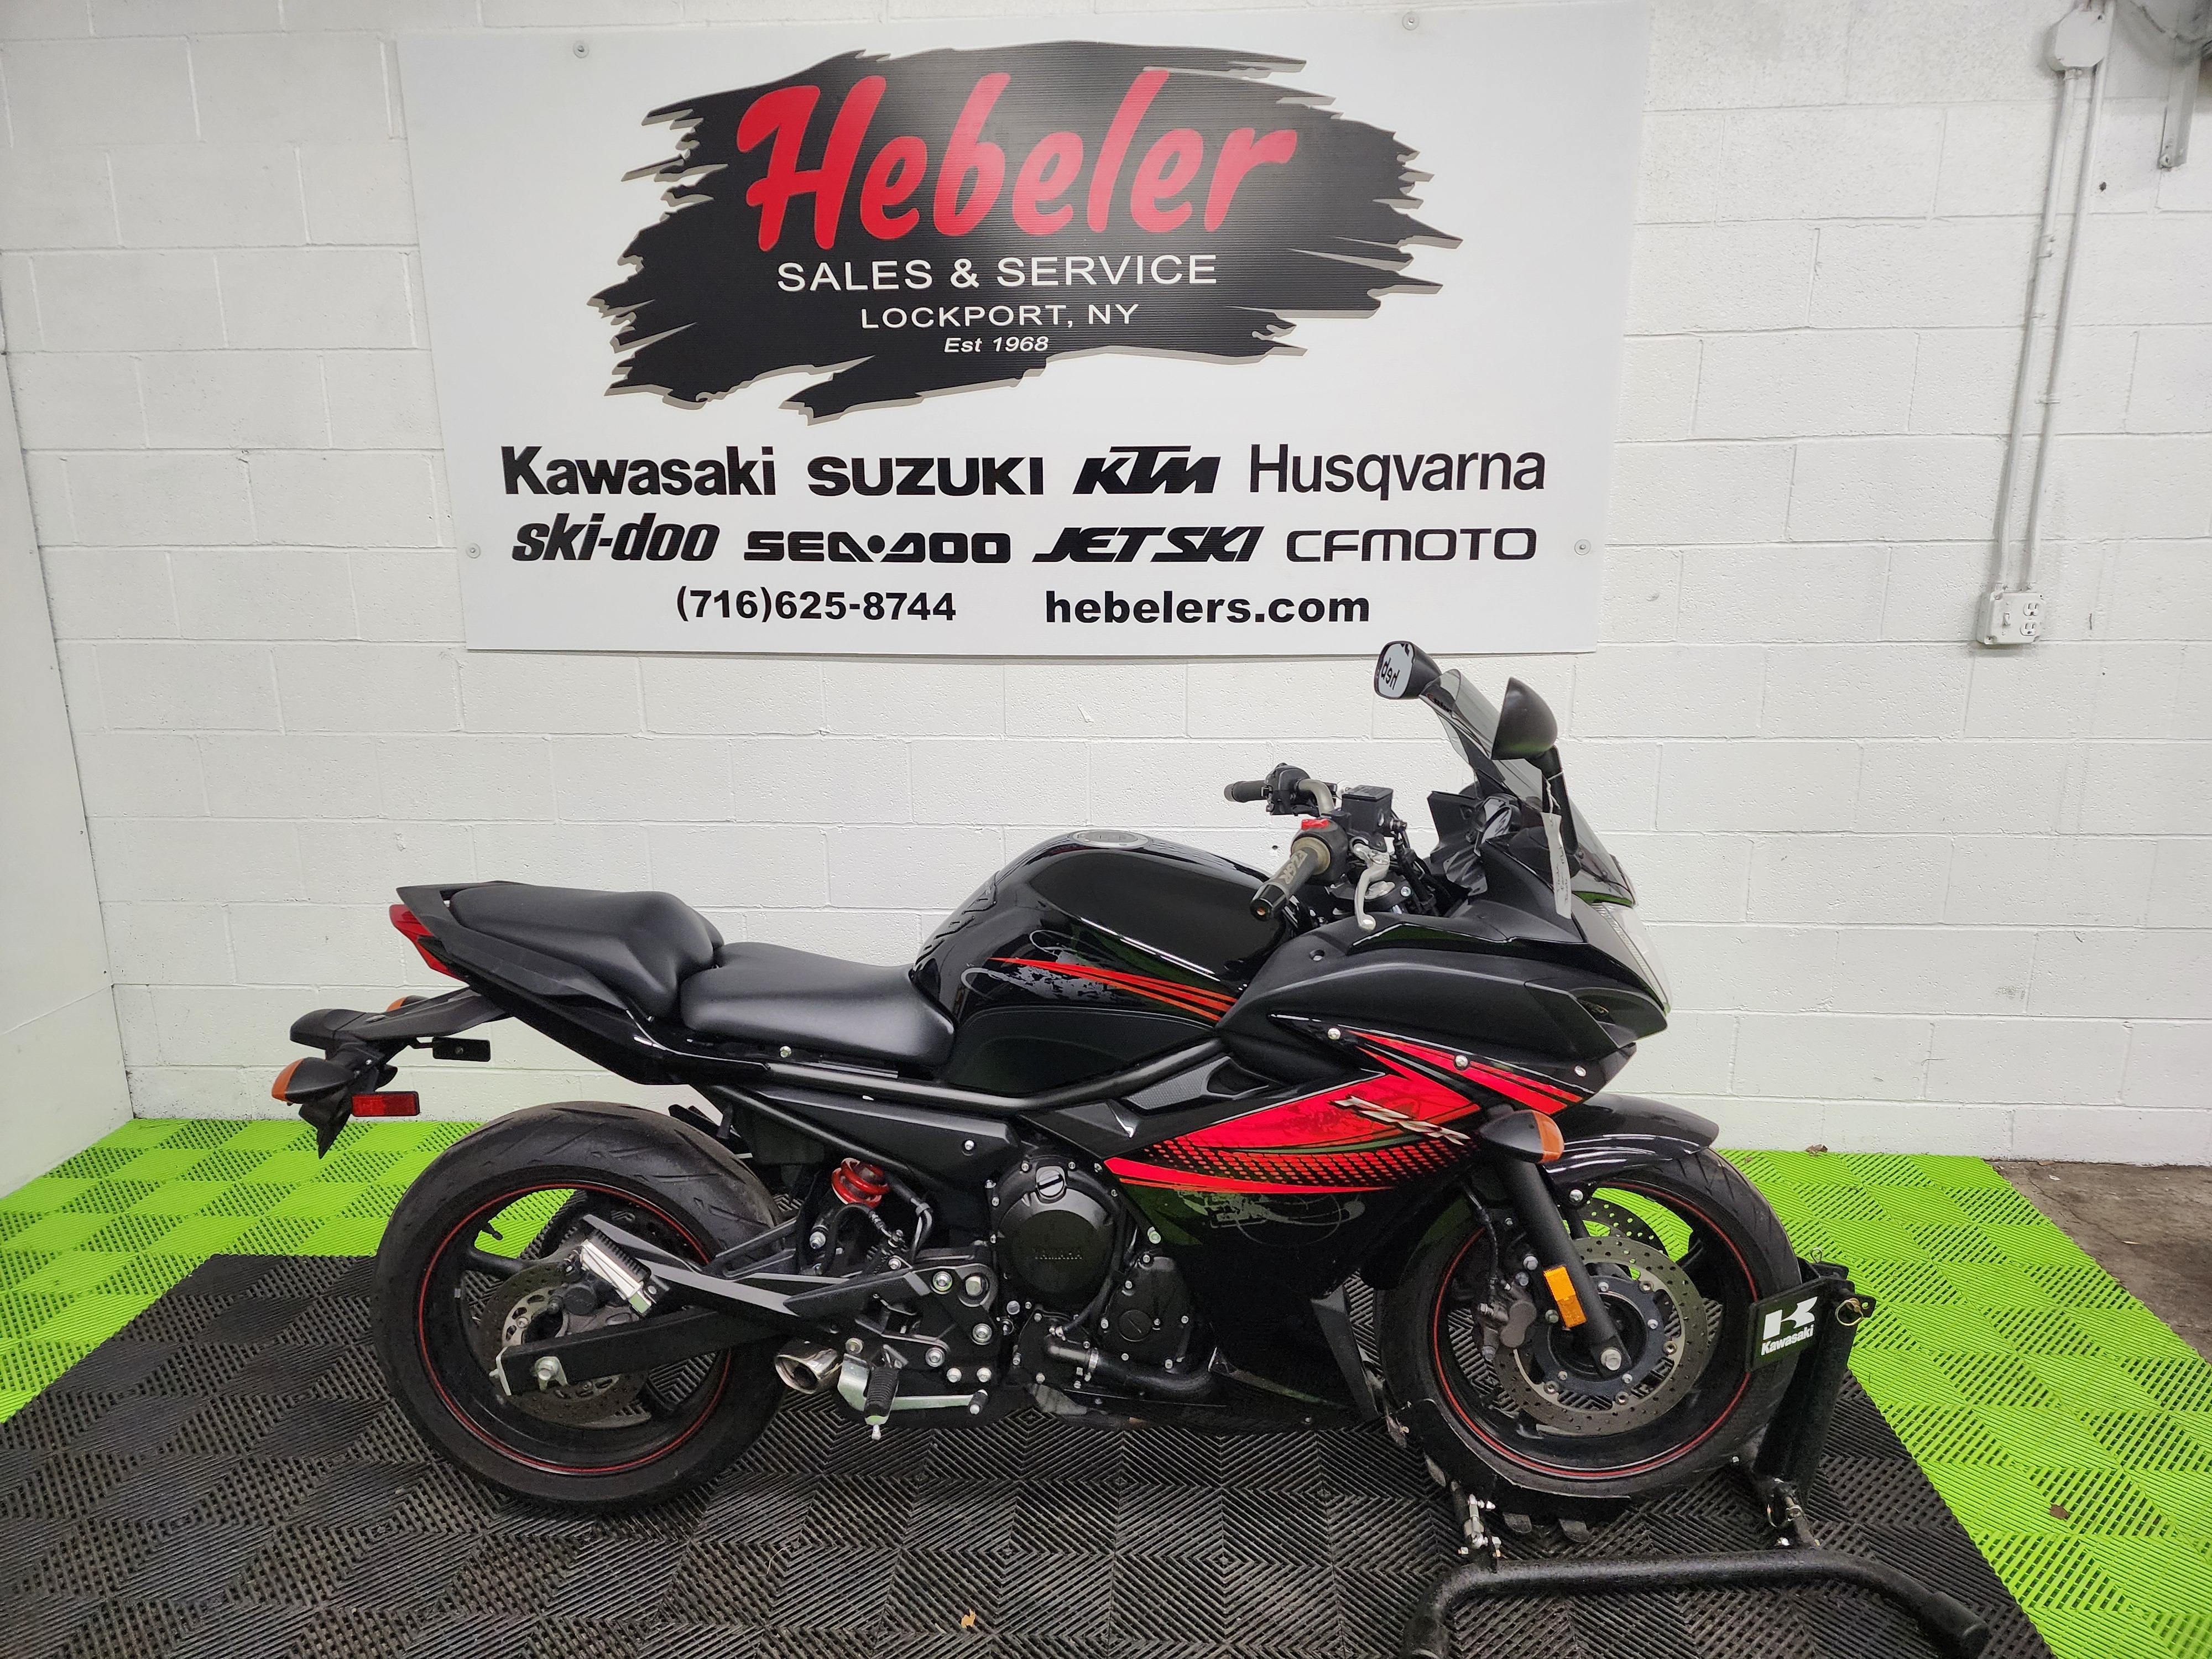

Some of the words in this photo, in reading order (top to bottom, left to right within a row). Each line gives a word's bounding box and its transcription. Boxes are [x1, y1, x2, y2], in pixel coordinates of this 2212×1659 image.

[737, 70, 1296, 252] Hebeler
[778, 259, 932, 291] SALES
[950, 259, 979, 288] &
[997, 254, 1217, 287] SERVICE
[861, 305, 1073, 328] LOCKPORT,
[1088, 304, 1139, 325] NY
[944, 337, 983, 353] Est
[993, 336, 1049, 352] 1968
[501, 446, 775, 496] Kawasaki
[807, 456, 1044, 497] SUZUKI
[1073, 446, 1220, 495] KTM
[1250, 444, 1545, 500] Husqvarna
[1287, 528, 1537, 562] CFMOTO
[677, 586, 956, 623] (716)625-8744
[1046, 590, 1369, 623] hebelers.com
[1761, 1324, 1814, 1356] Kawasaki
